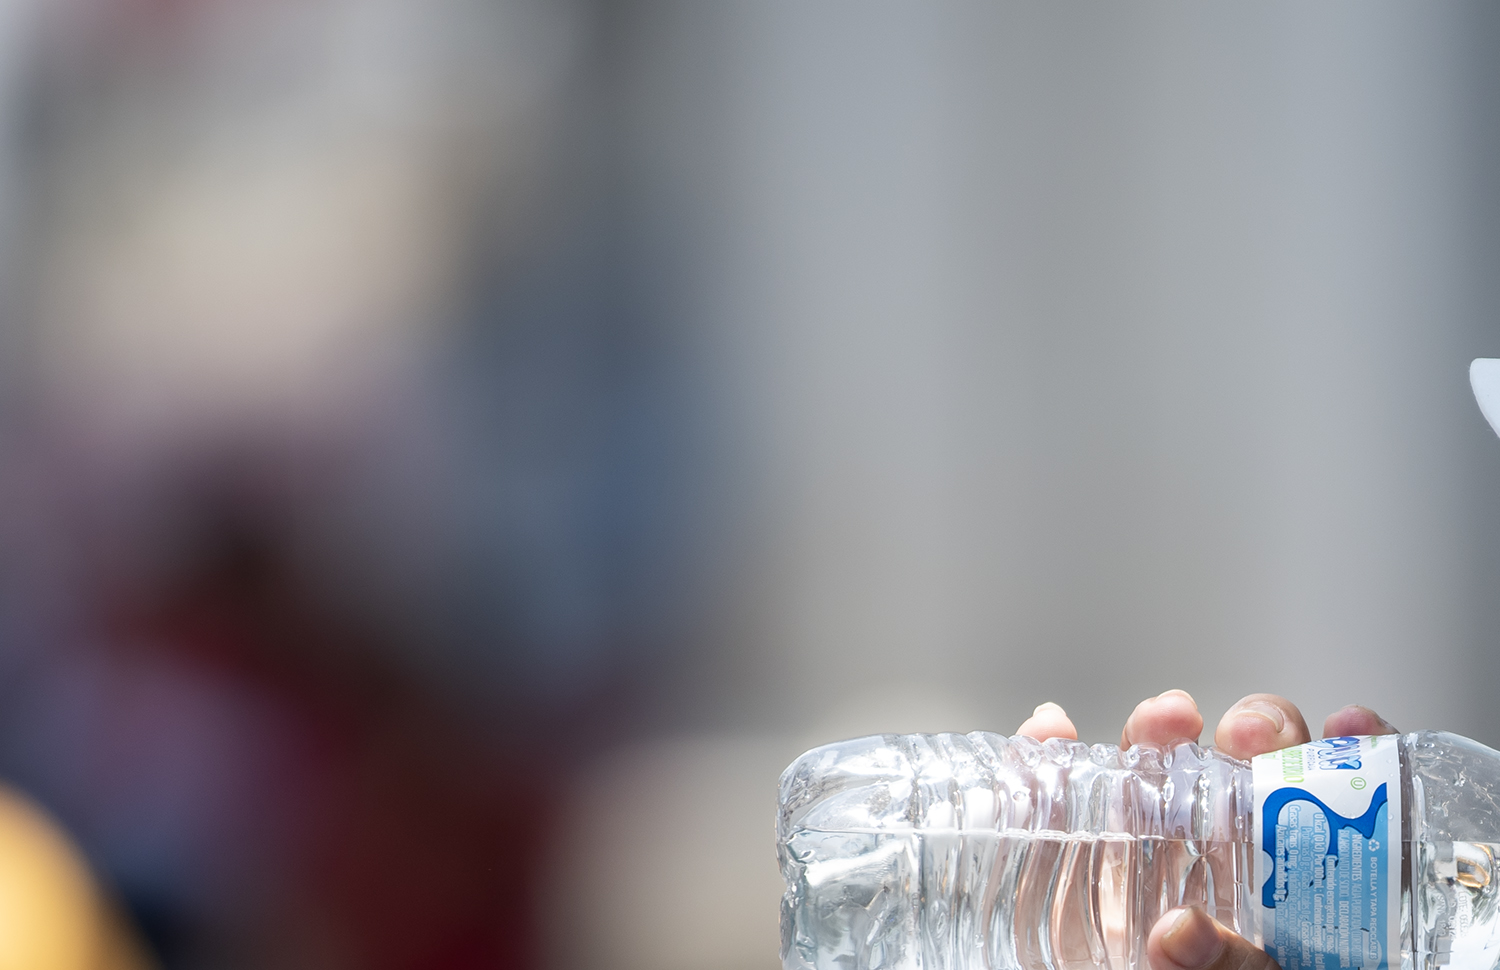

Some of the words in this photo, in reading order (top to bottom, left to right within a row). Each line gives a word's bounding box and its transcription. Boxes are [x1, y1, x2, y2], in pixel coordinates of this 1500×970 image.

[1290, 806, 1300, 828] Grasas
[1314, 819, 1324, 833] kcal
[1276, 825, 1287, 856] Azúcares
[1289, 829, 1299, 848] trans
[1314, 834, 1324, 842] (0
[1339, 830, 1350, 870] BICARBONATO
[1314, 854, 1324, 866] Por
[1301, 870, 1311, 889] Grasas
[1314, 866, 1324, 878] 100
[1326, 855, 1337, 890] Contenido
[1339, 871, 1350, 879] DE
[1289, 870, 1299, 894] Hidratos
[1352, 883, 1362, 899] AGUA
[1276, 902, 1287, 915] Fibra
[1301, 890, 1311, 909] totales
[1314, 893, 1324, 924] Contenido
[1325, 890, 1336, 923] energético
[1301, 921, 1312, 938] Grasas
[1325, 924, 1334, 933] por
